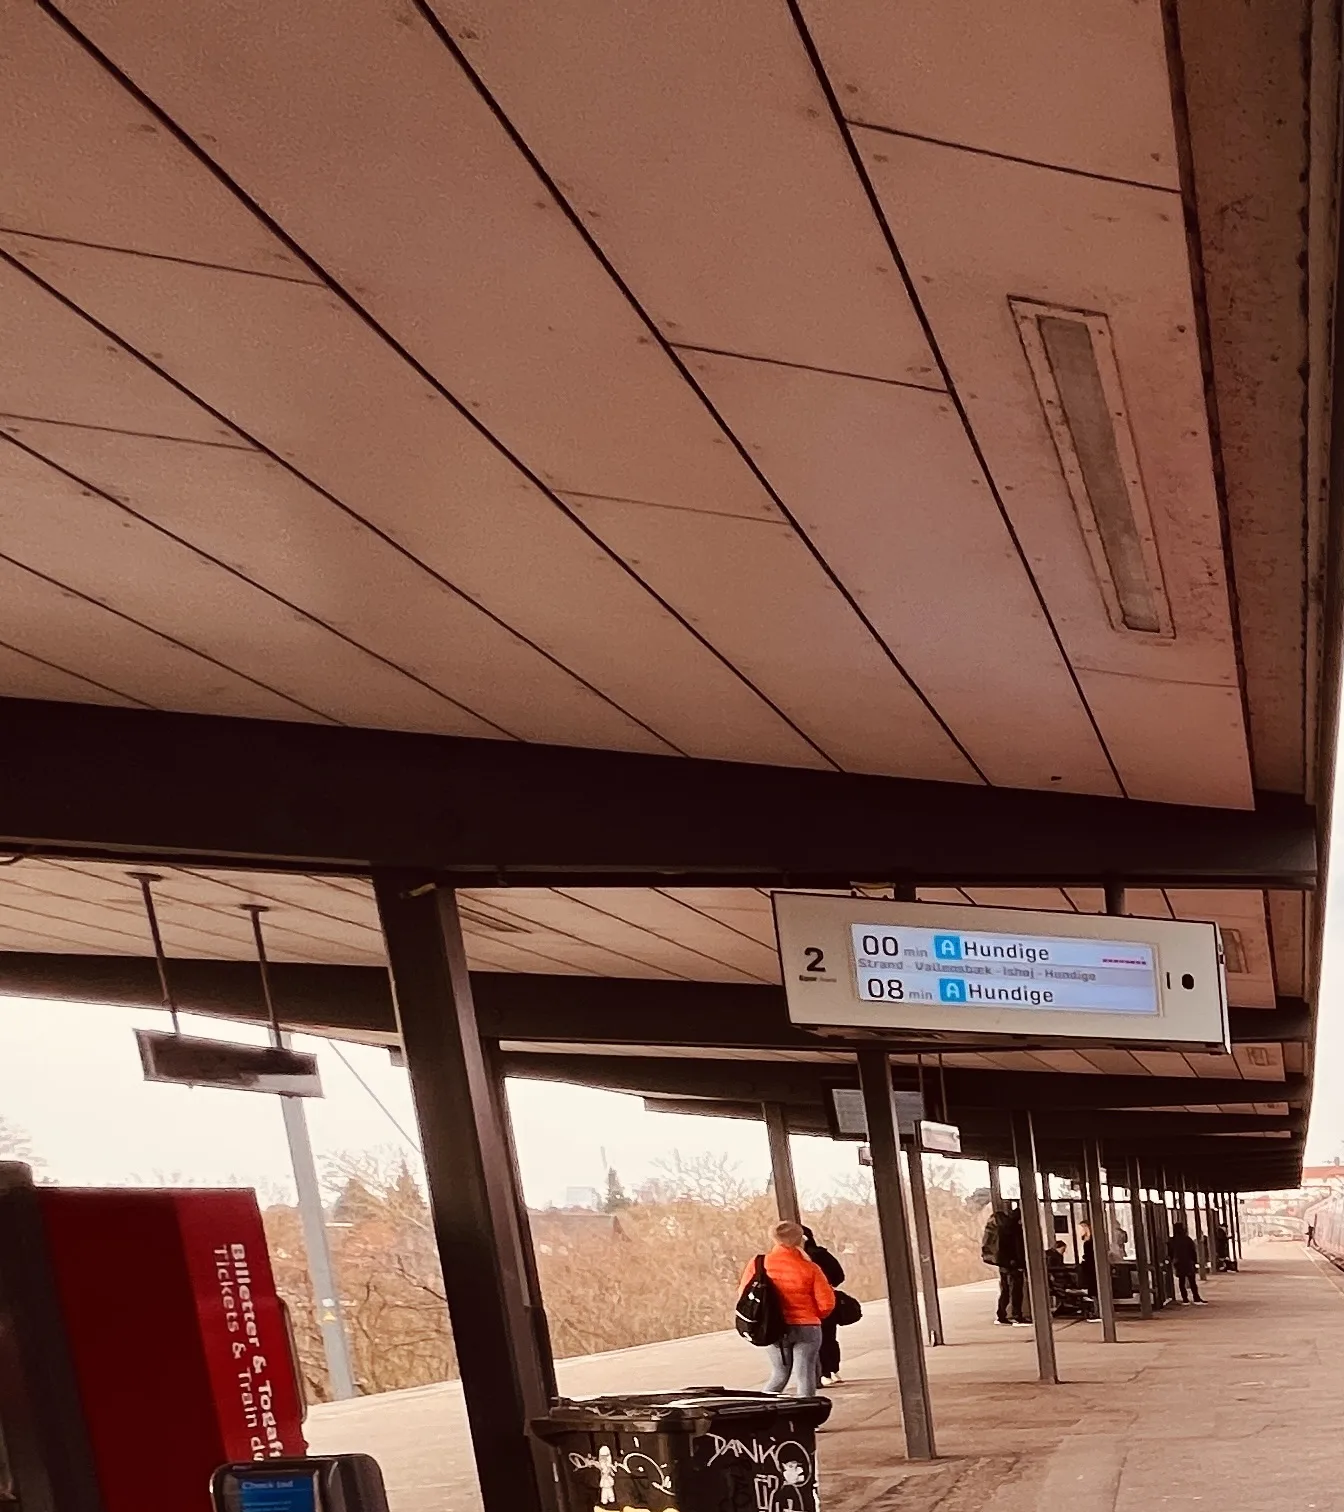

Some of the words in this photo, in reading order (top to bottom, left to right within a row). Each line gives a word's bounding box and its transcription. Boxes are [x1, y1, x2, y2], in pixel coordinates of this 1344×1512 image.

[804, 947, 826, 972] 2
[861, 934, 899, 957] 00
[903, 947, 928, 958] min
[964, 941, 1050, 962] Hundige
[857, 958, 904, 970] Strand
[1044, 970, 1097, 982] Hundige
[867, 978, 904, 1000] 08
[908, 990, 933, 1000] min
[968, 983, 1054, 1005] Hundige
[213, 1244, 240, 1333] Tickets
[230, 1243, 260, 1348] Billetter
[252, 1355, 267, 1374] &
[231, 1341, 247, 1360] &
[237, 1367, 258, 1428] Train
